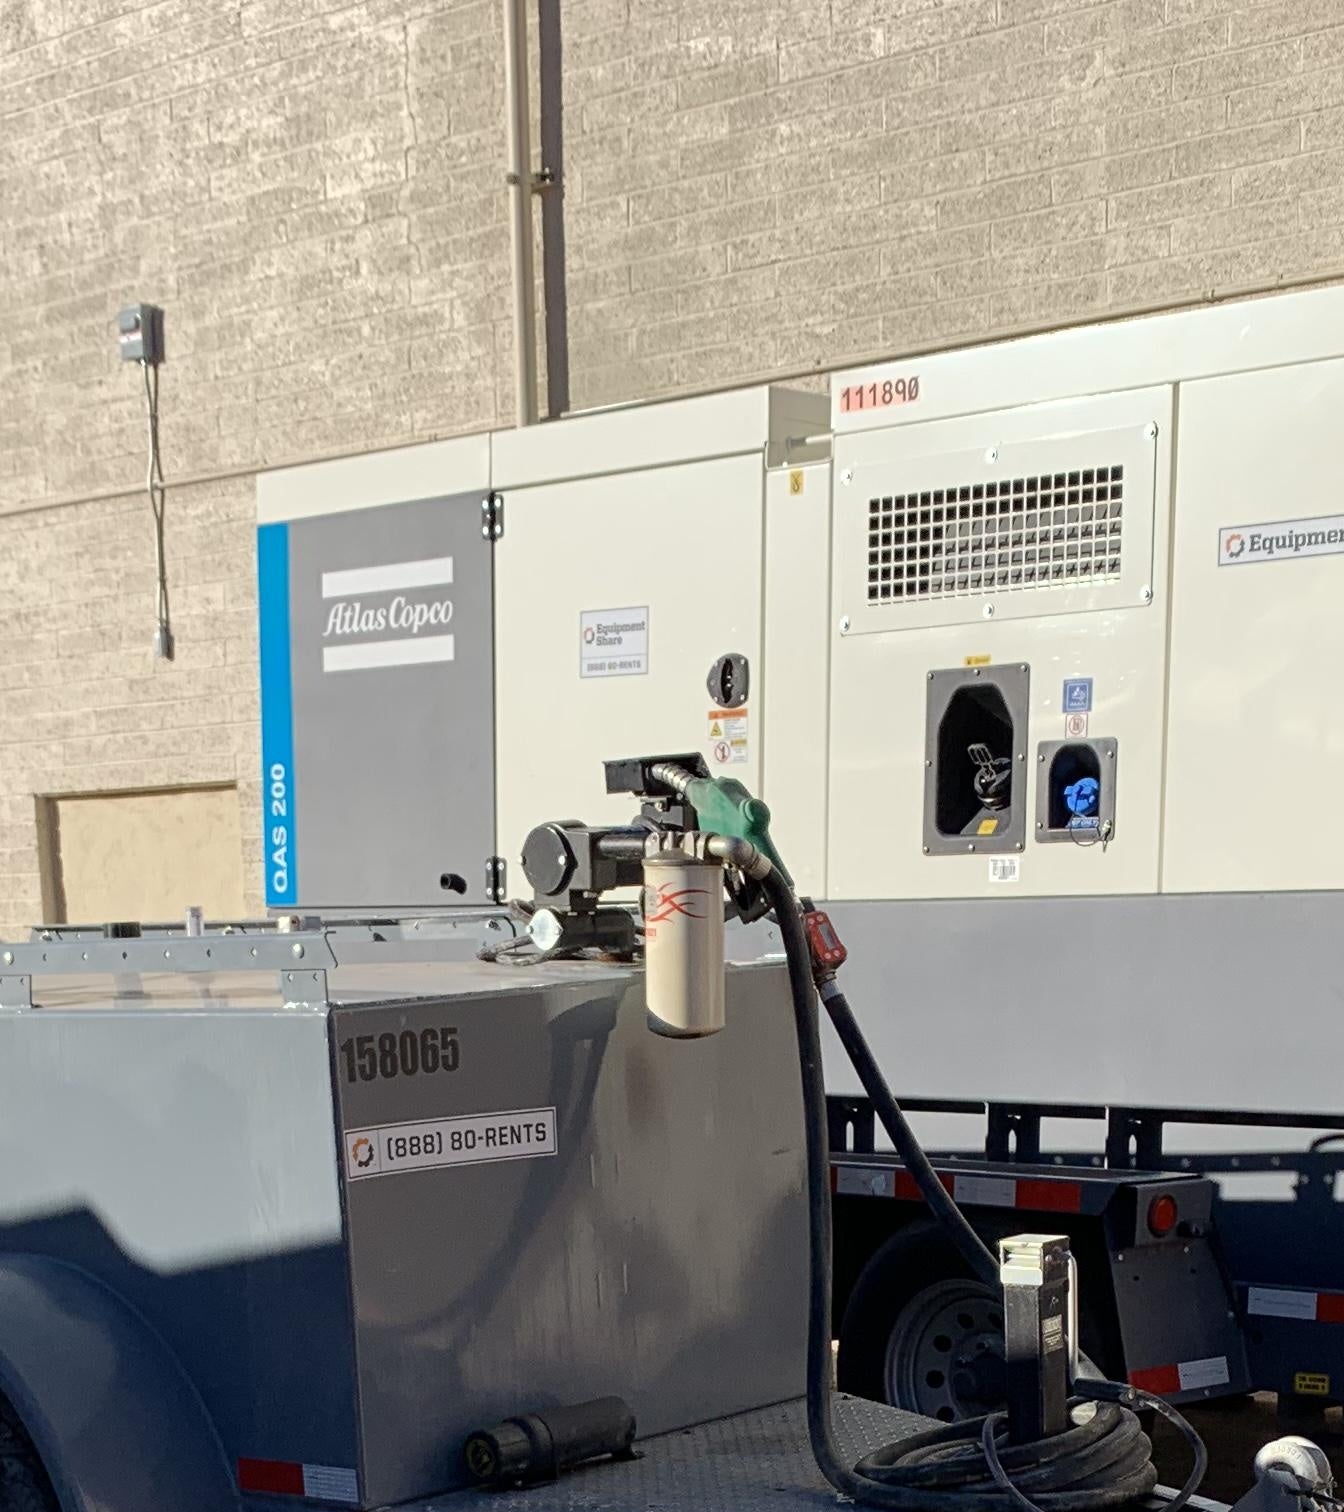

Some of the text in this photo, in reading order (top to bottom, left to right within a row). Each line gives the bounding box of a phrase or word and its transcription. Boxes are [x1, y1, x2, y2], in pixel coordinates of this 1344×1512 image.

[842, 375, 920, 411] 111890
[322, 596, 454, 637] Atlas Copco
[596, 621, 646, 635] Equipment
[596, 636, 623, 646] Share
[270, 763, 288, 893] QAS 200
[341, 1027, 460, 1083] 158065
[387, 1122, 547, 1161] (888) 80-RENTS
